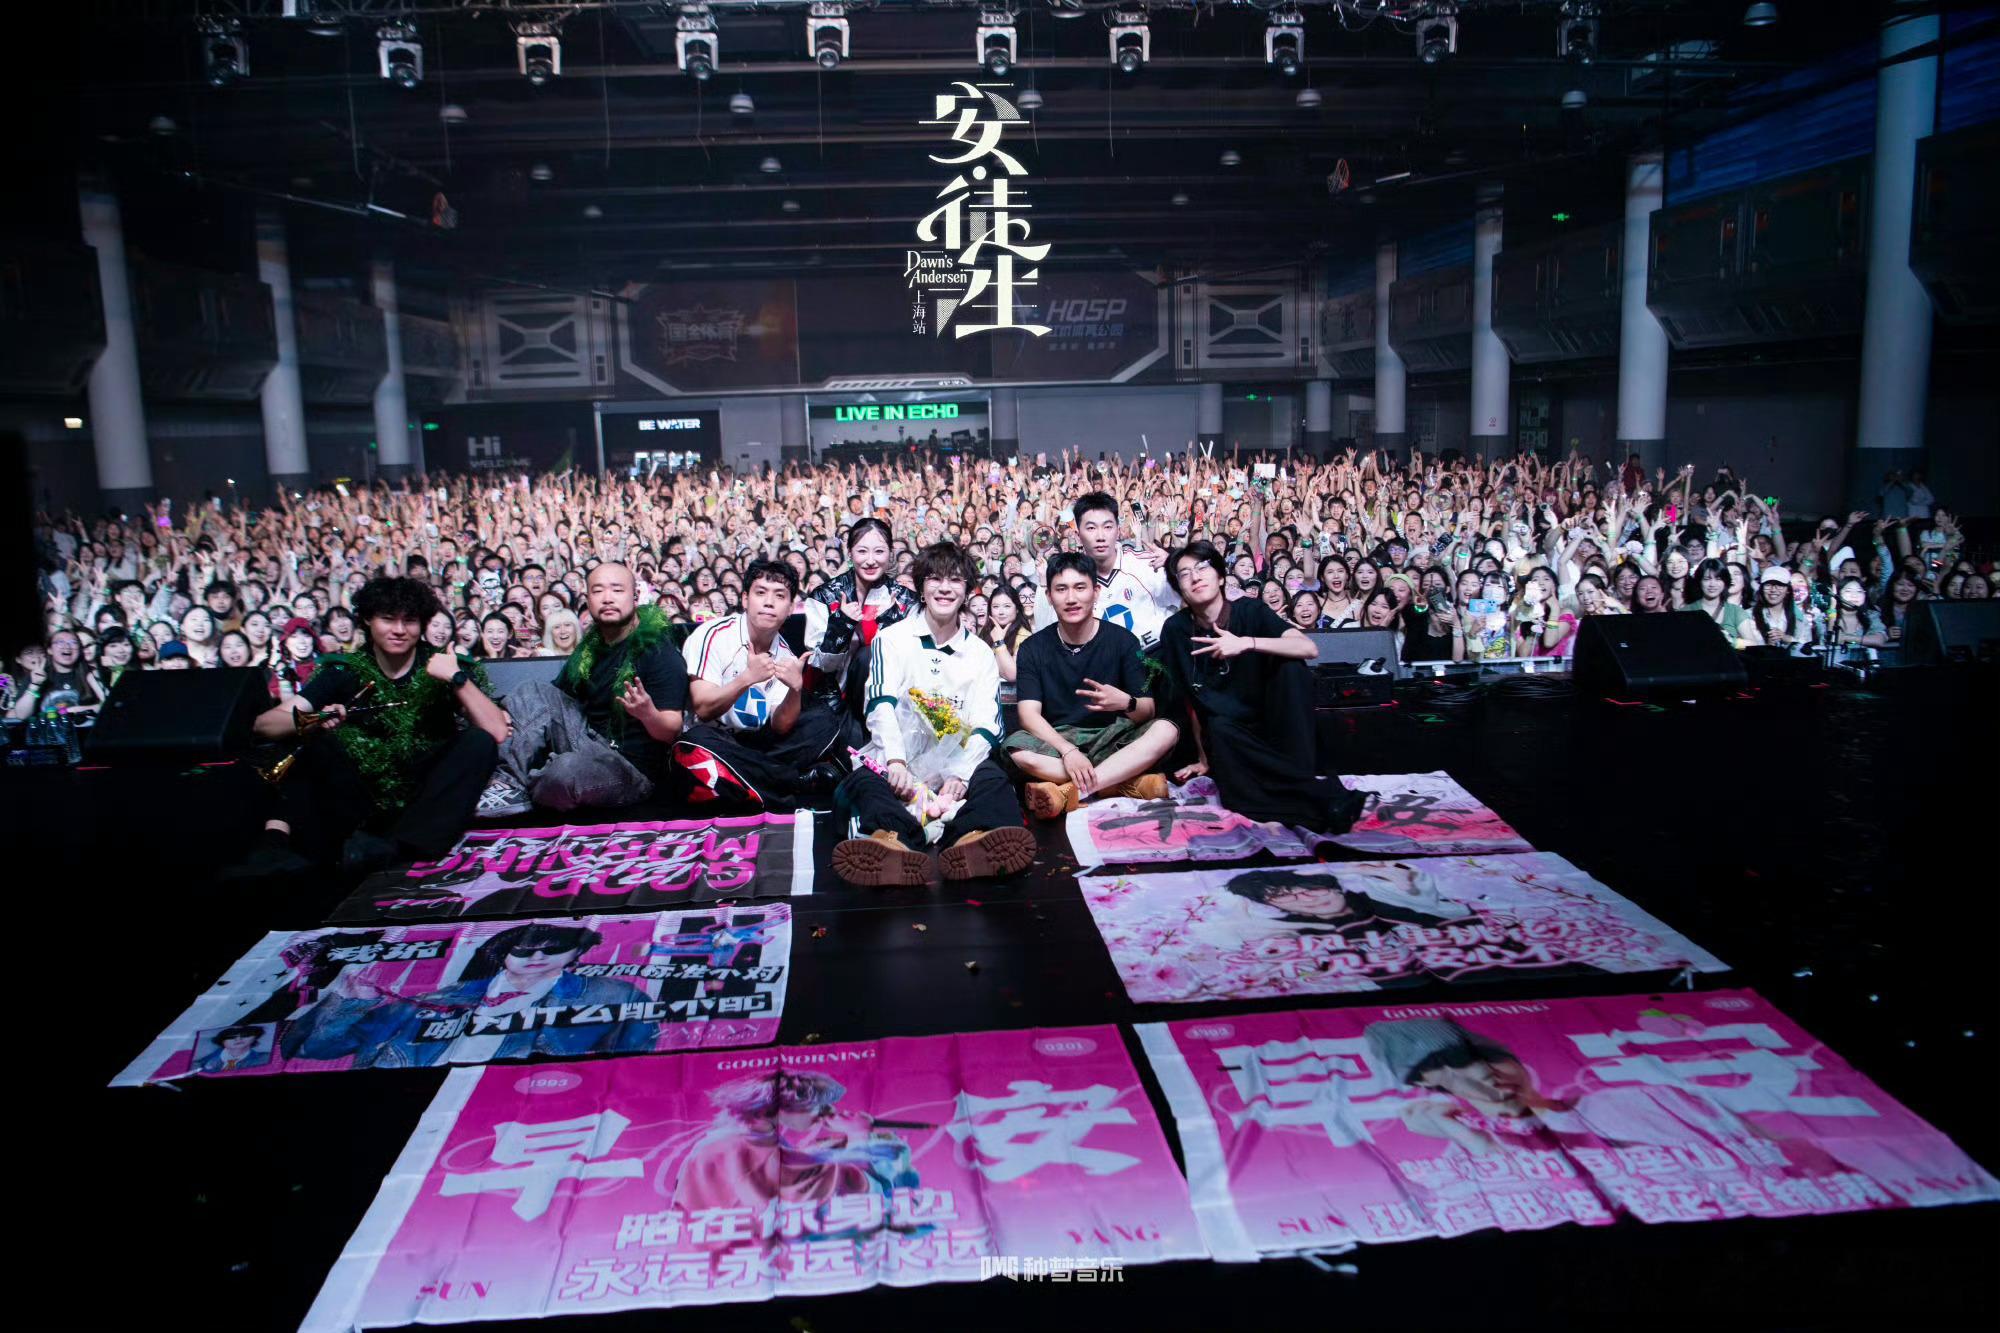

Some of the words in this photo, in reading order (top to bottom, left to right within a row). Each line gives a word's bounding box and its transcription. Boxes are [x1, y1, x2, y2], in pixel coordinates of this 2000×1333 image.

[835, 405, 880, 421] LIVE
[884, 405, 904, 420] IN
[907, 403, 959, 419] ECHO
[638, 419, 656, 430] BE
[656, 418, 701, 429] WATER
[467, 436, 501, 456] Hi
[326, 940, 443, 963] 我说
[575, 963, 779, 981] 你的标准不对
[1044, 1041, 1084, 1052] 0201
[529, 1078, 568, 1088] 1993
[1211, 1036, 1420, 1147] 早
[439, 1108, 645, 1222] 早
[945, 1080, 1142, 1181] 安
[616, 1187, 960, 1250] 陪在你身边
[1277, 1214, 1347, 1236] SUN
[415, 1279, 493, 1301] SUN
[1066, 1222, 1161, 1244] YANG
[559, 1228, 996, 1301] 永远永远永远
